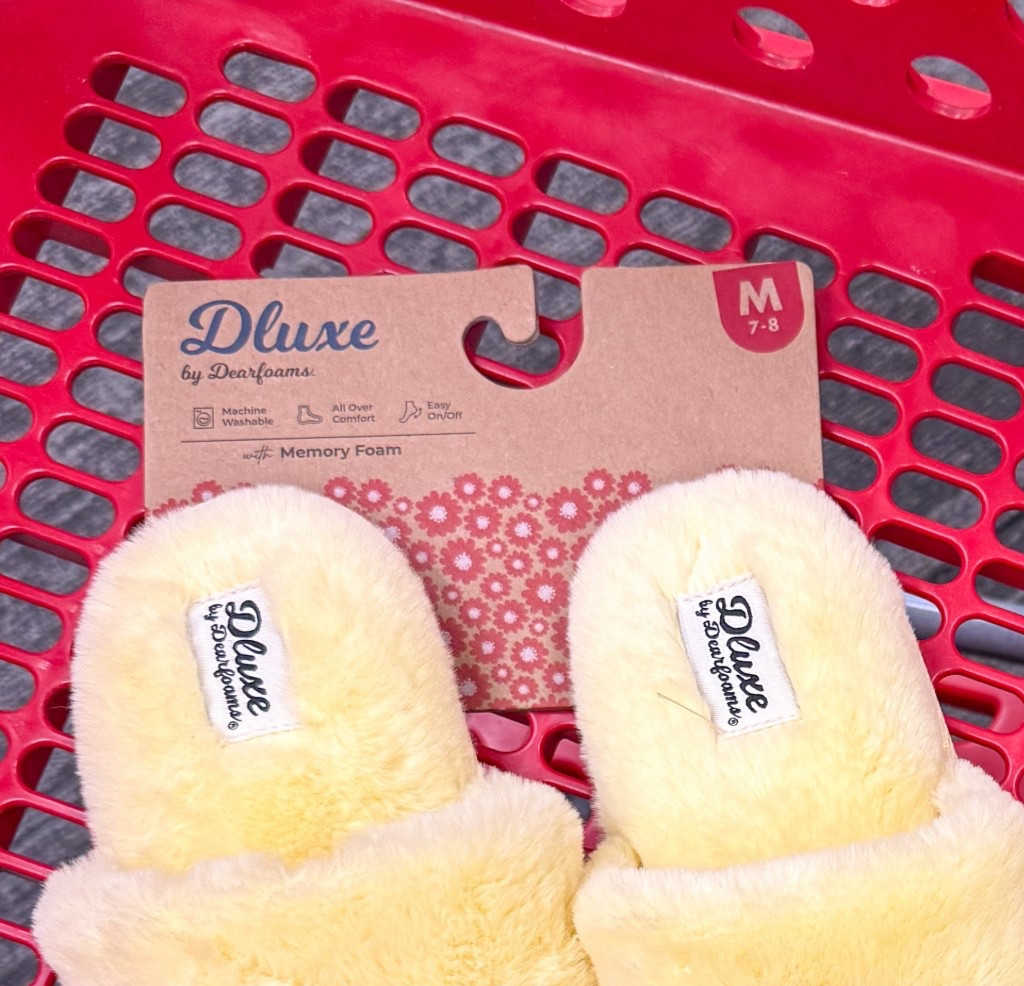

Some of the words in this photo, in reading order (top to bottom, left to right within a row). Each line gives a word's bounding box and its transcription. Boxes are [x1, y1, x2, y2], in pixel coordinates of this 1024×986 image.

[739, 277, 783, 316] M
[180, 300, 379, 356] Dluxe
[748, 317, 779, 335] 7-8
[181, 364, 203, 386] by
[221, 406, 268, 417] Machine
[332, 403, 346, 414] All
[348, 403, 373, 413] Over
[426, 411, 463, 422] On/Off
[427, 401, 451, 413] Easy
[222, 417, 274, 427] Washable
[333, 414, 376, 424] Comfort
[242, 445, 274, 464] with
[280, 446, 350, 460] Memory
[355, 444, 402, 457] Foam
[203, 603, 224, 622] by
[695, 599, 714, 619] by
[224, 599, 272, 717] Dluxe
[716, 595, 769, 714] Dluxe
